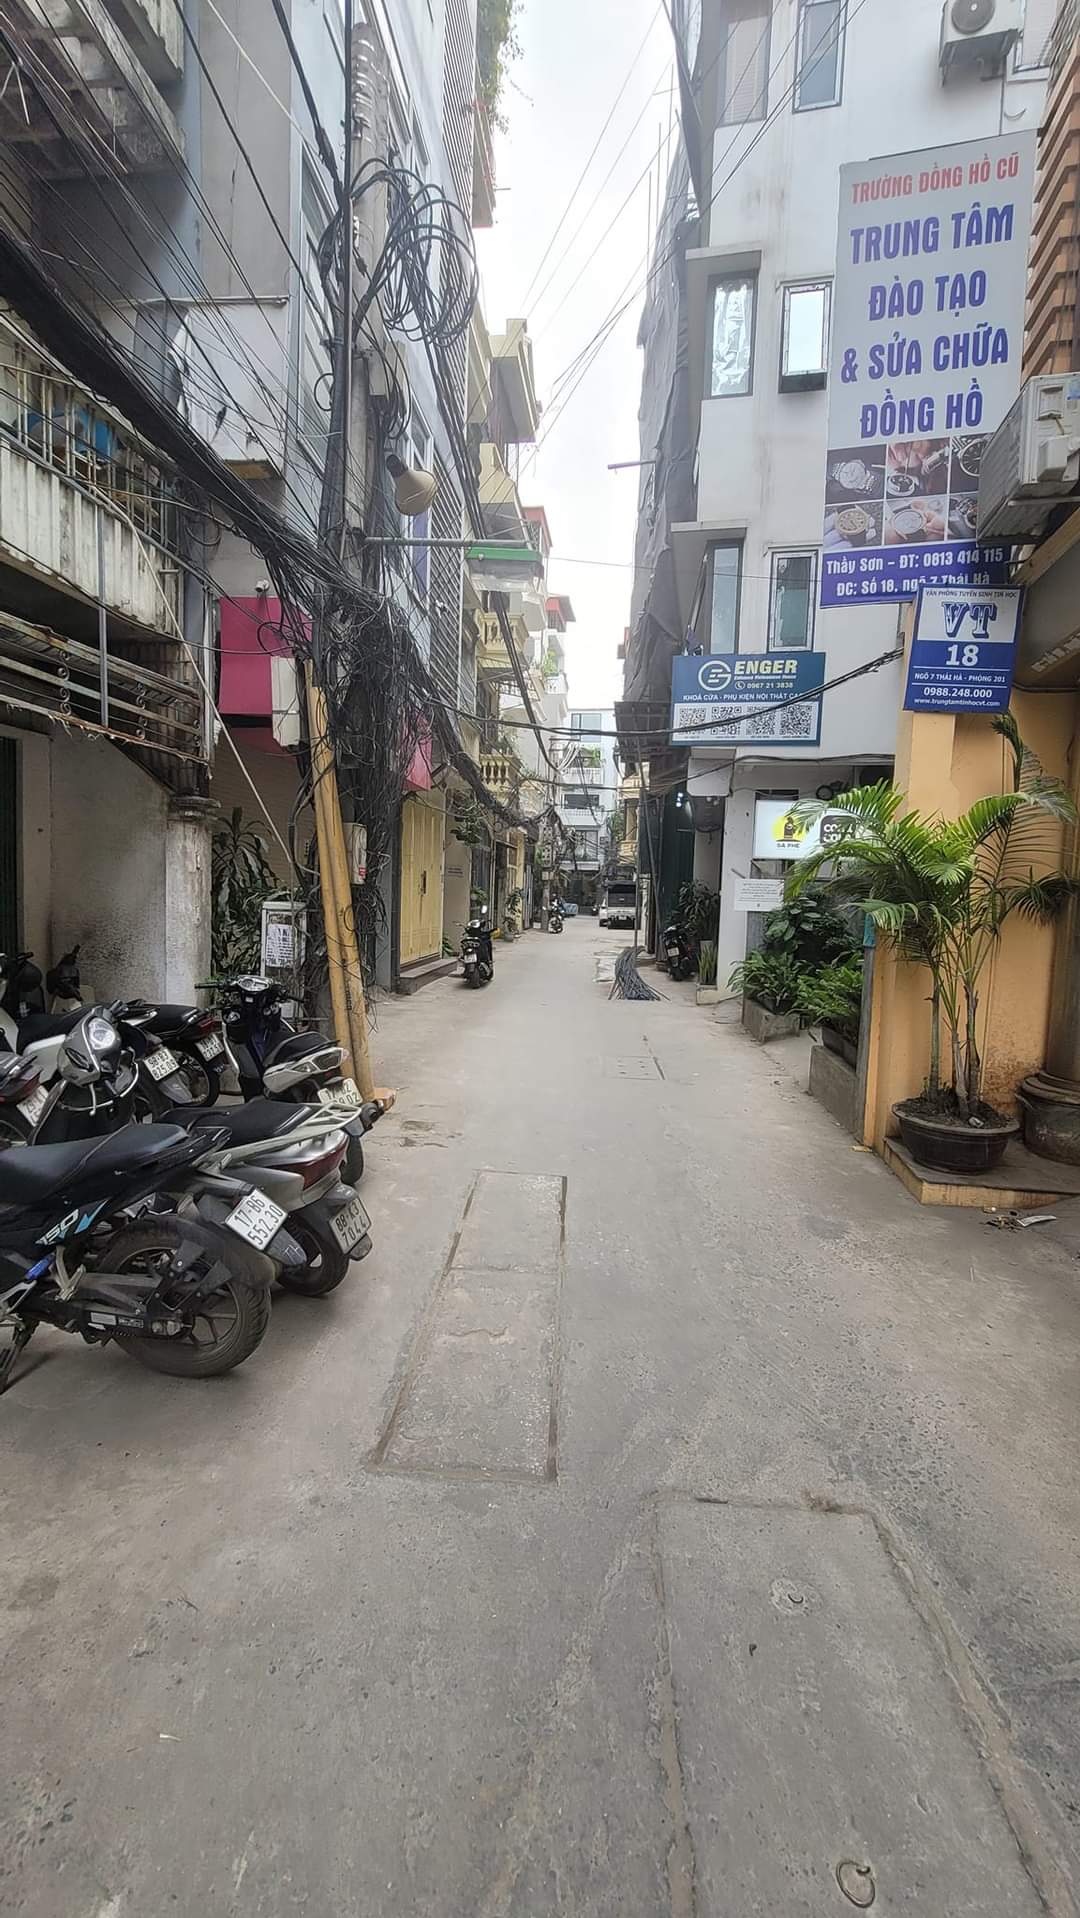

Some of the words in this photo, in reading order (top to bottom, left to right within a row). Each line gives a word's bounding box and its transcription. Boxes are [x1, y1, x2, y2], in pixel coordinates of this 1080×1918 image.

[851, 173, 913, 204] TRƯỜNG
[969, 153, 991, 184] HỒ
[997, 151, 1019, 179] CŨ
[849, 216, 940, 265] TRUNG
[951, 202, 1015, 249] TÂM
[868, 275, 925, 321] ĐÀO
[935, 269, 987, 317] TẠO
[840, 347, 858, 384] &
[867, 331, 922, 380] SỬA
[932, 321, 1009, 372] CHỮA
[859, 388, 934, 439] ĐỒNG
[945, 377, 984, 430] HỒ
[827, 556, 856, 574] Thầy
[860, 557, 884, 571] Sơn
[923, 552, 953, 567] 0813
[957, 550, 979, 564] 414
[984, 548, 1003, 563] 115
[861, 576, 877, 594] Số
[941, 602, 998, 639] VT
[734, 659, 798, 674] ENGER
[946, 644, 980, 667] 18
[923, 687, 993, 698] 0988.248.000
[953, 673, 963, 681] HÀ
[234, 1195, 266, 1227] 17-B6
[247, 1204, 284, 1245] 552.30
